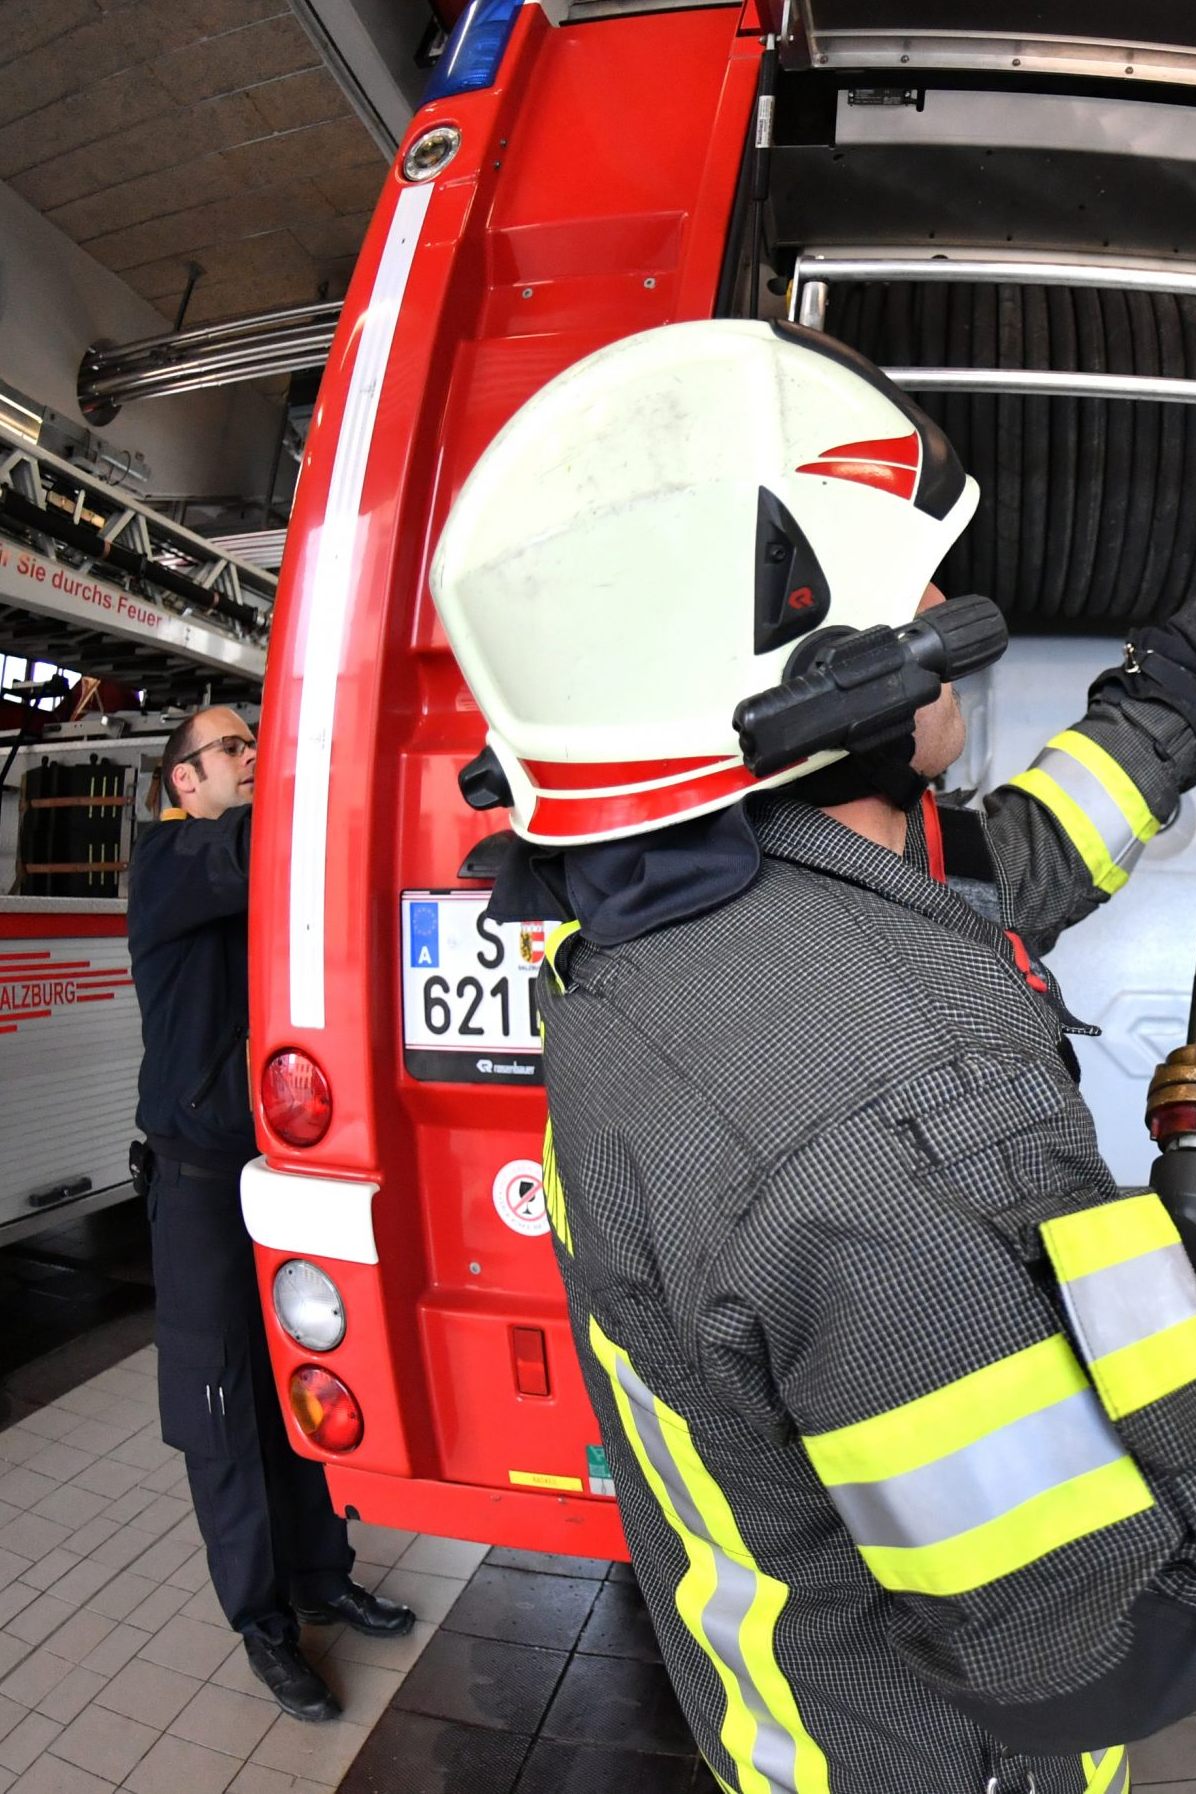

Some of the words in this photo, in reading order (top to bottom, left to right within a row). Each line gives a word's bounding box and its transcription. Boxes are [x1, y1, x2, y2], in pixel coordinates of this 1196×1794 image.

[17, 553, 47, 582] Sie
[52, 570, 112, 609] durchs
[117, 596, 163, 627] Feuer
[418, 945, 433, 964] A
[476, 909, 505, 970] S
